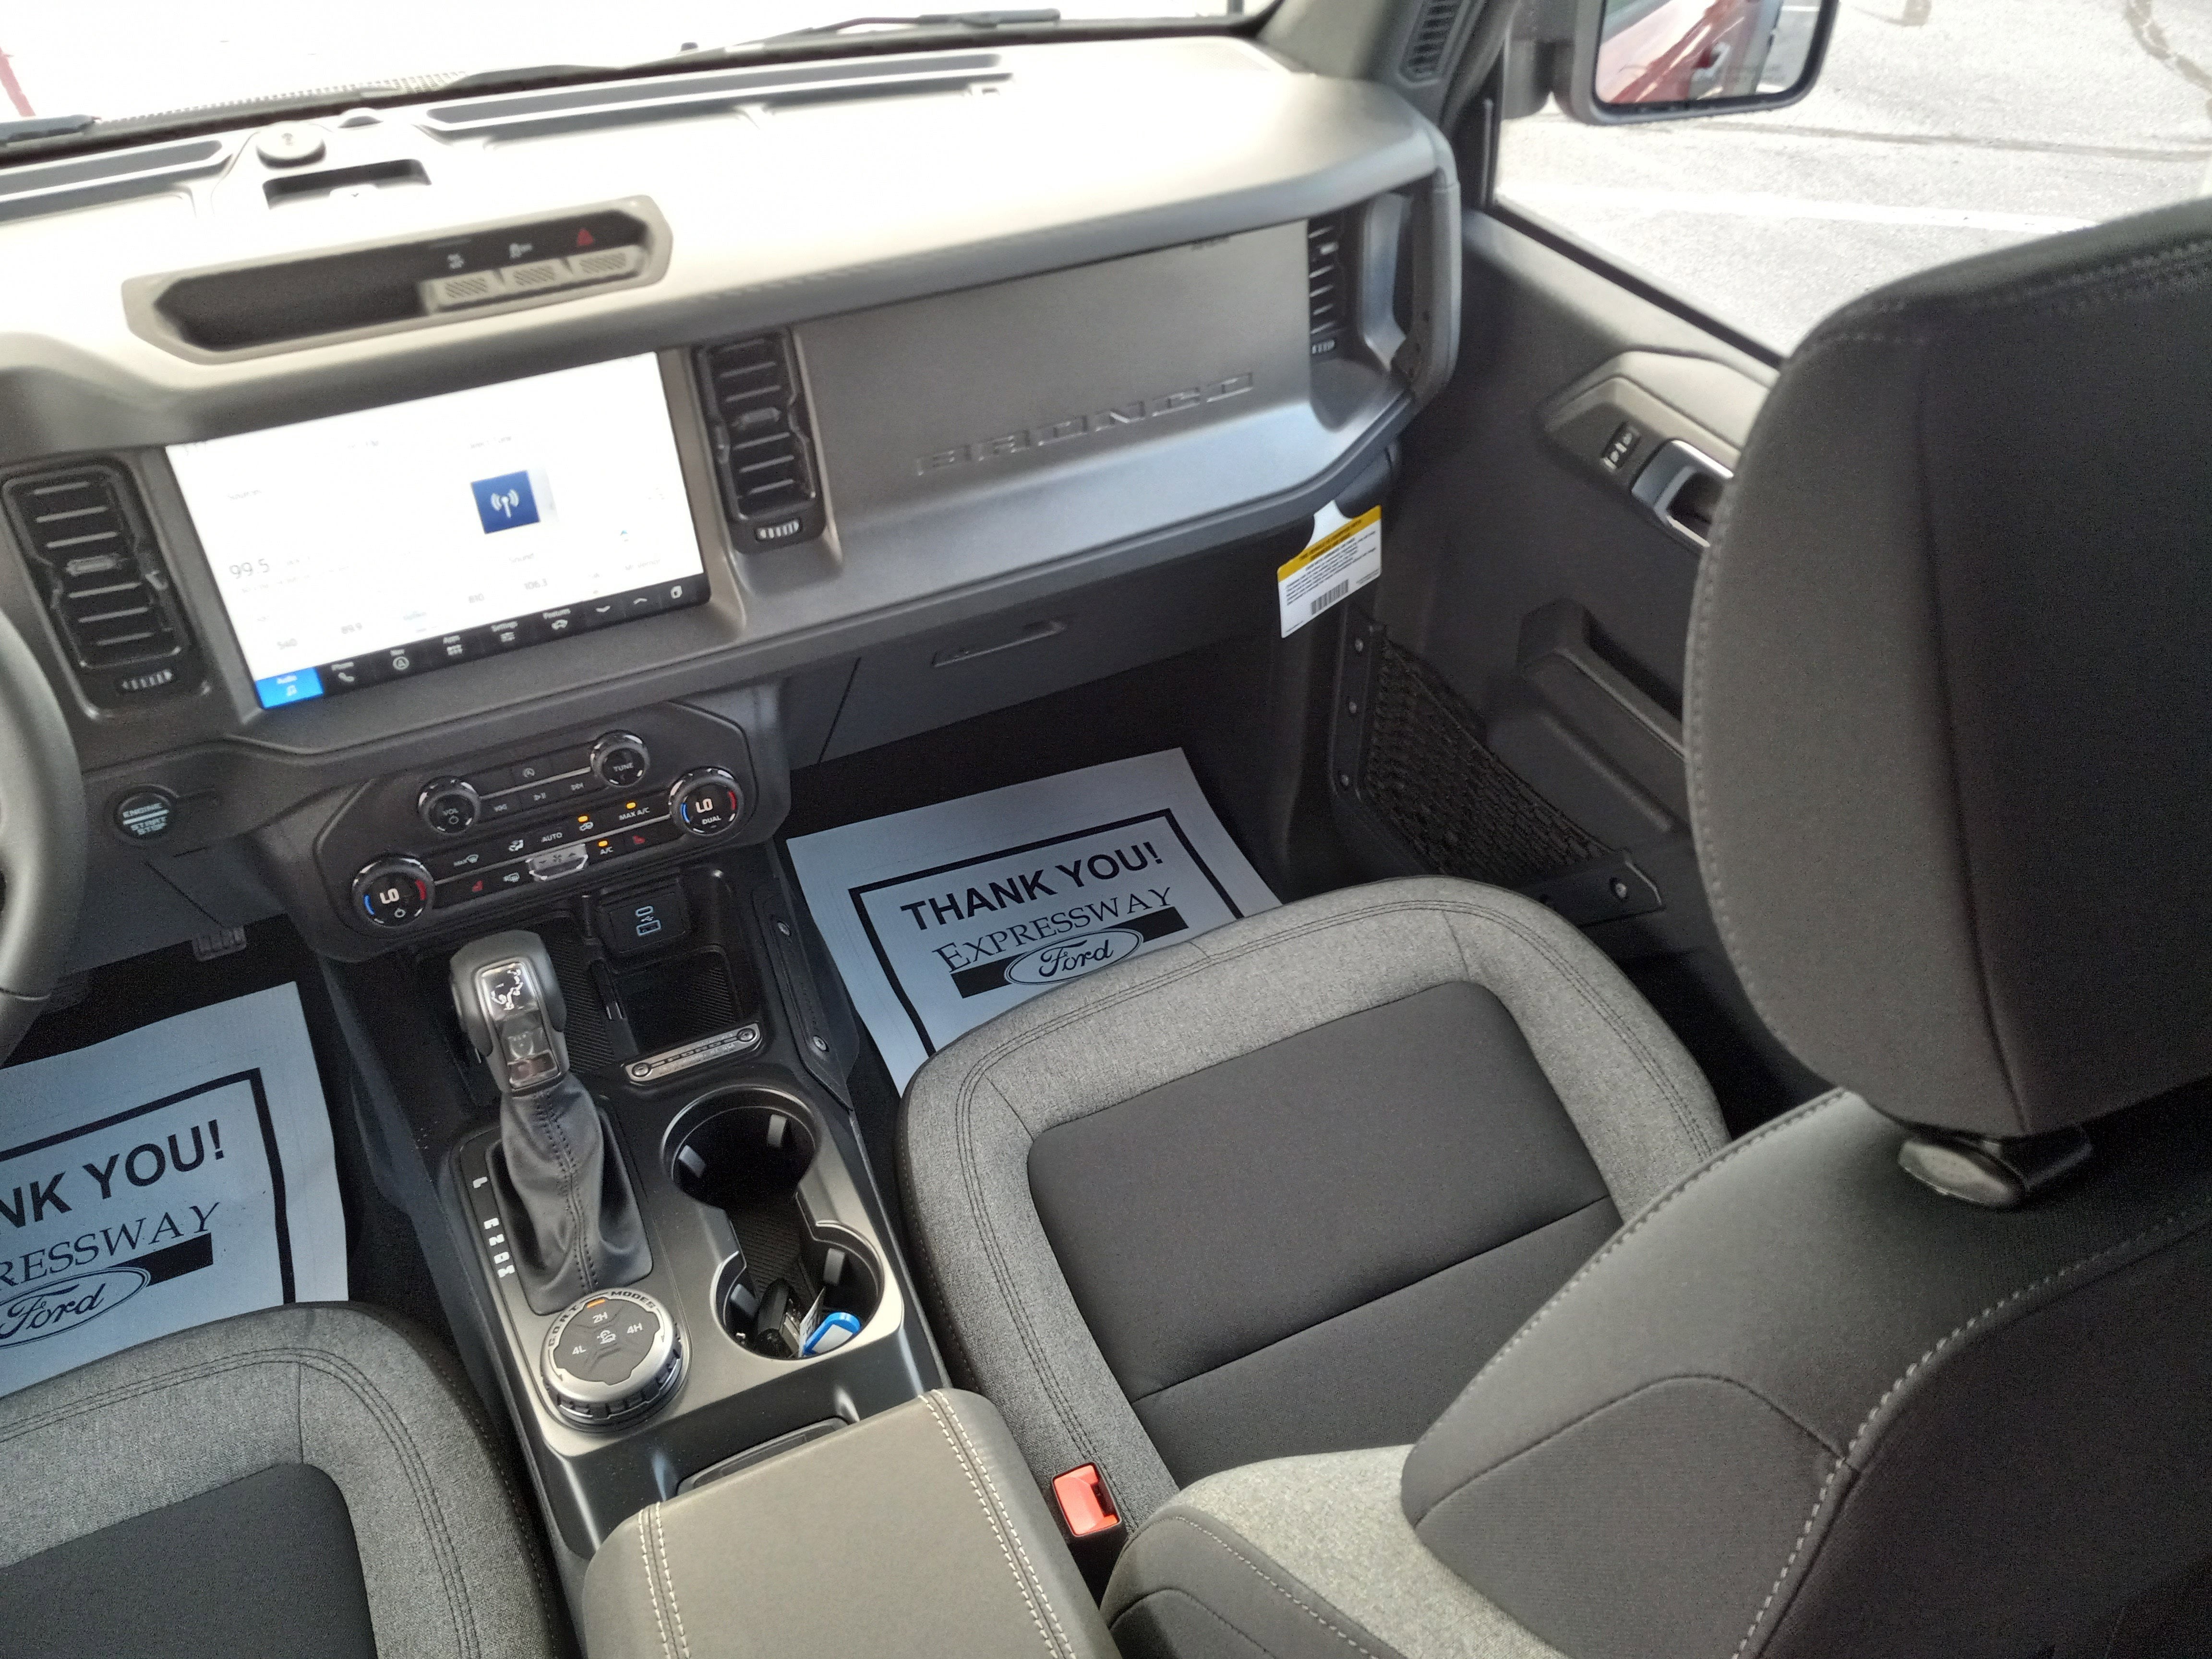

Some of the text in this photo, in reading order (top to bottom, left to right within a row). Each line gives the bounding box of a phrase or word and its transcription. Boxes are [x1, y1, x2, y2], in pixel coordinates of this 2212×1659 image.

[915, 372, 1253, 476] BRONCO
[229, 558, 270, 578] 99.5
[613, 762, 634, 773] TUNE
[122, 803, 164, 818] ENGINE
[443, 807, 459, 817] VOL
[618, 806, 650, 821] MAX A/C
[695, 798, 714, 814] LO
[131, 817, 168, 831] START
[701, 815, 722, 826] DUAL
[137, 822, 168, 836] STOP
[541, 831, 564, 843] AUTO
[600, 846, 614, 856] A/C
[901, 841, 1164, 932] THANK YOU!
[380, 888, 400, 904] LO
[932, 886, 1173, 973] EXPRESSWAY
[1038, 938, 1114, 978] Ford
[82, 1119, 225, 1199] YOU!
[489, 1234, 505, 1246] N
[611, 1291, 656, 1309] MODES
[0, 1283, 106, 1340] Ford
[592, 1311, 608, 1323] 2H
[626, 1322, 643, 1334] 4H
[572, 1345, 587, 1355] 4L
